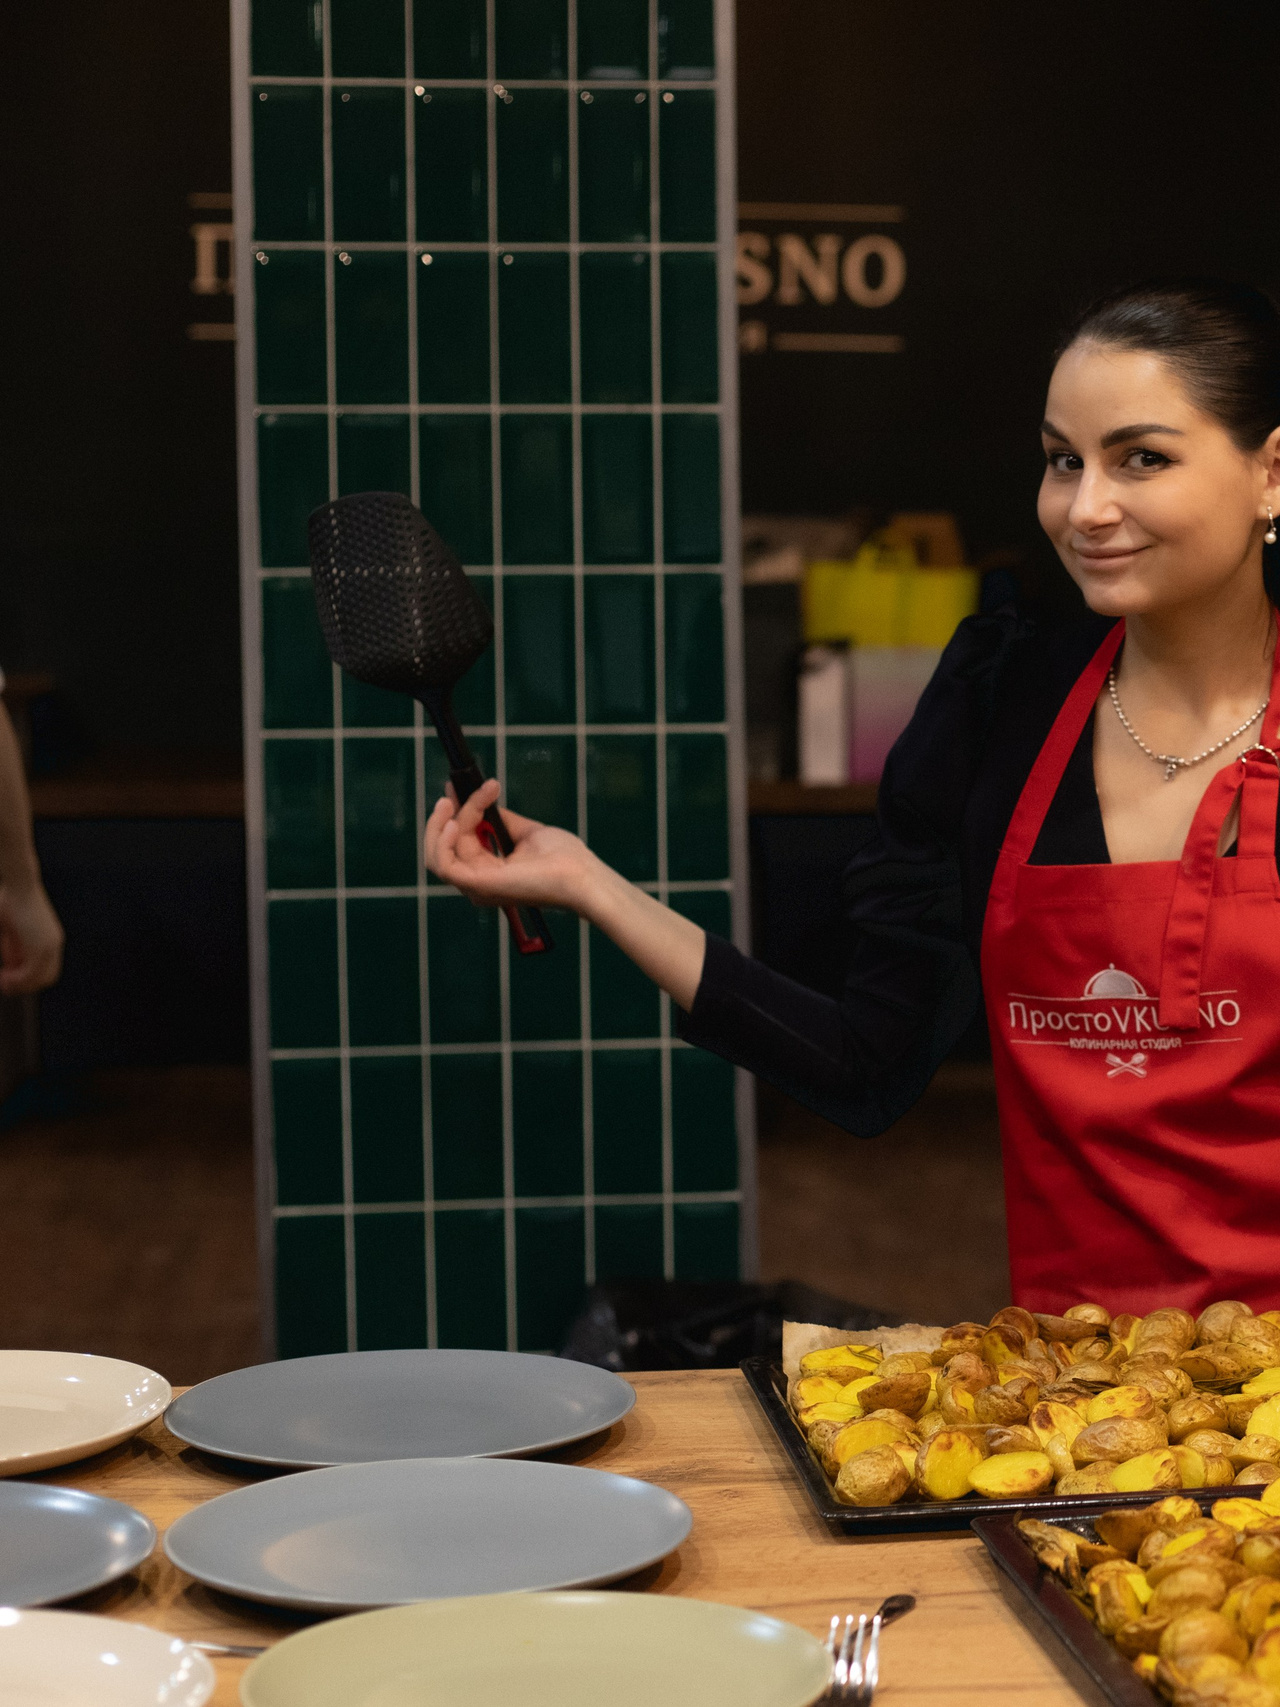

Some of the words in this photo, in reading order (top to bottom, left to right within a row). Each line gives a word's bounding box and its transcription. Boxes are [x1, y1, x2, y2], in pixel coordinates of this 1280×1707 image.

[1009, 999, 1241, 1035] ПростоVKUNO
[1069, 1037, 1138, 1050] КУЛИНАРНАЯ
[1140, 1037, 1182, 1050] СТУДИЯ
